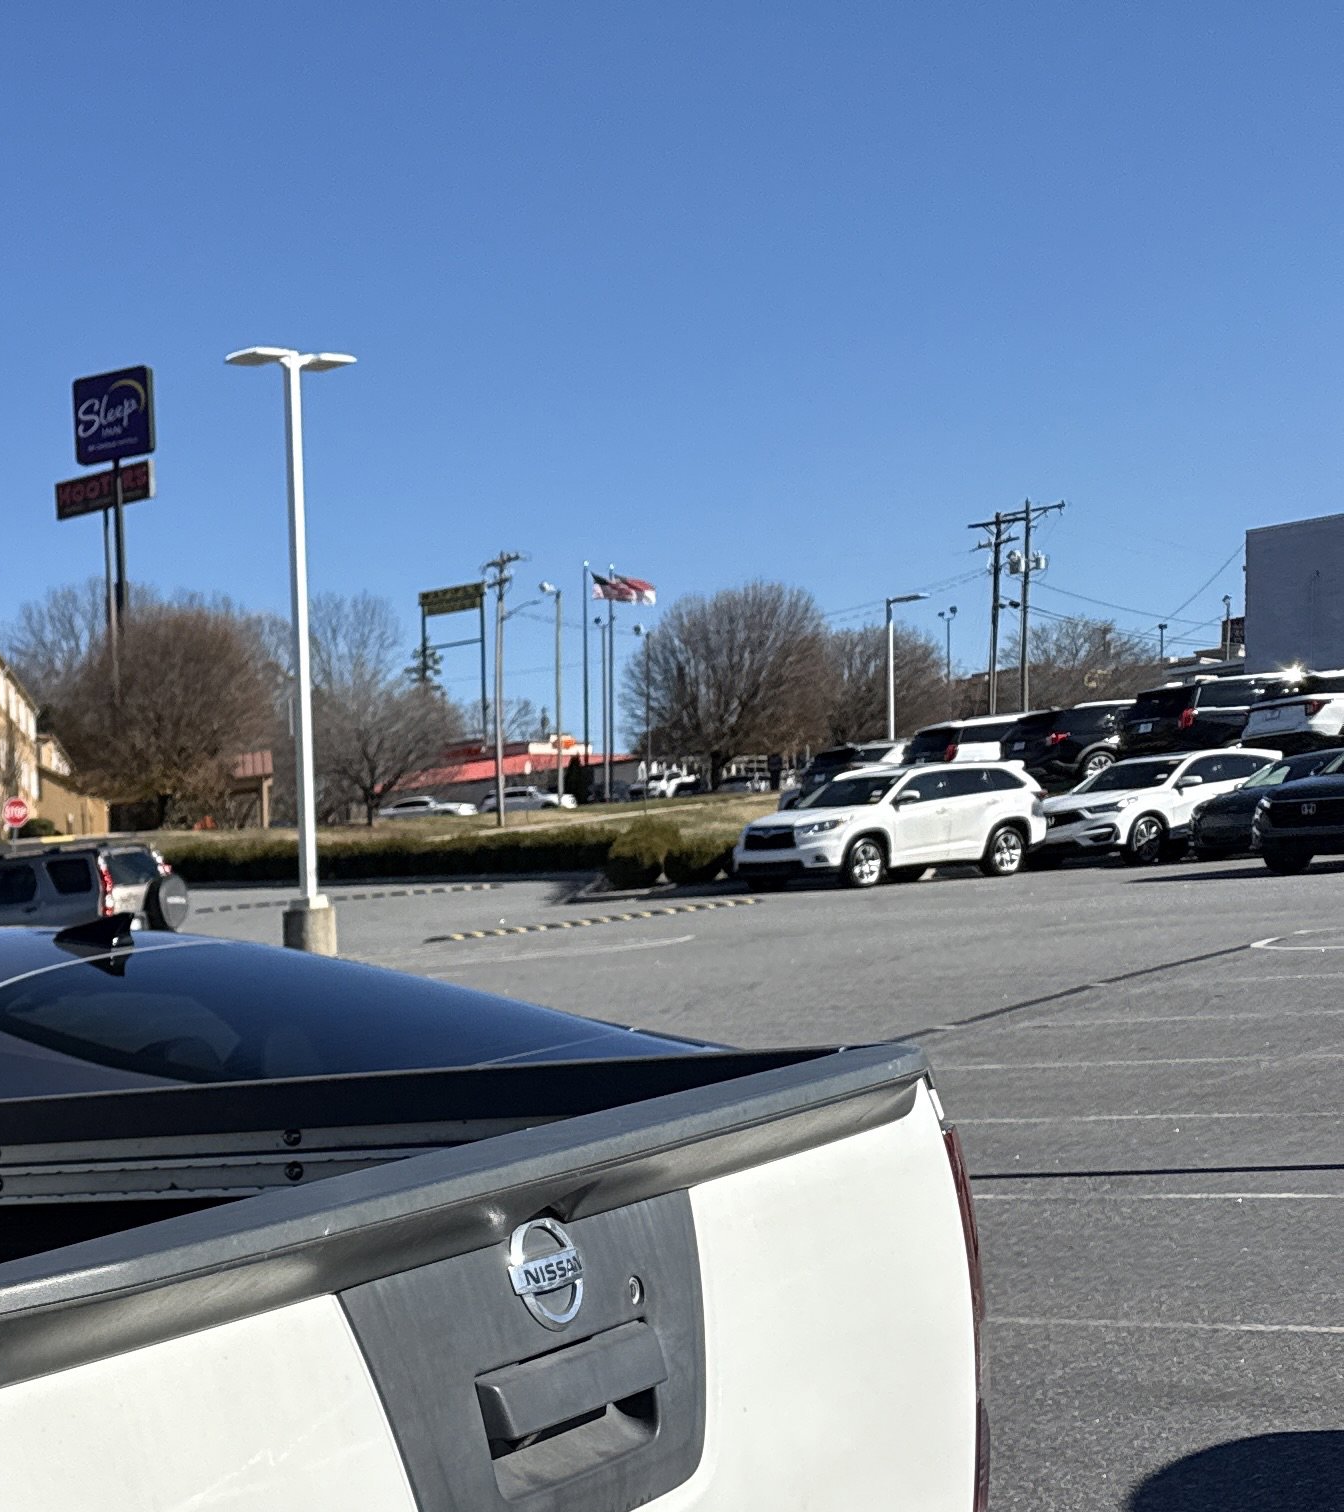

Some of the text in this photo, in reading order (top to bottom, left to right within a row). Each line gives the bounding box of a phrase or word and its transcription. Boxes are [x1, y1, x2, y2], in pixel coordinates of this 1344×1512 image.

[78, 394, 138, 438] Sleep
[58, 468, 148, 506] HOOTRS
[4, 805, 27, 818] STOP
[523, 1255, 583, 1287] NISSAN
